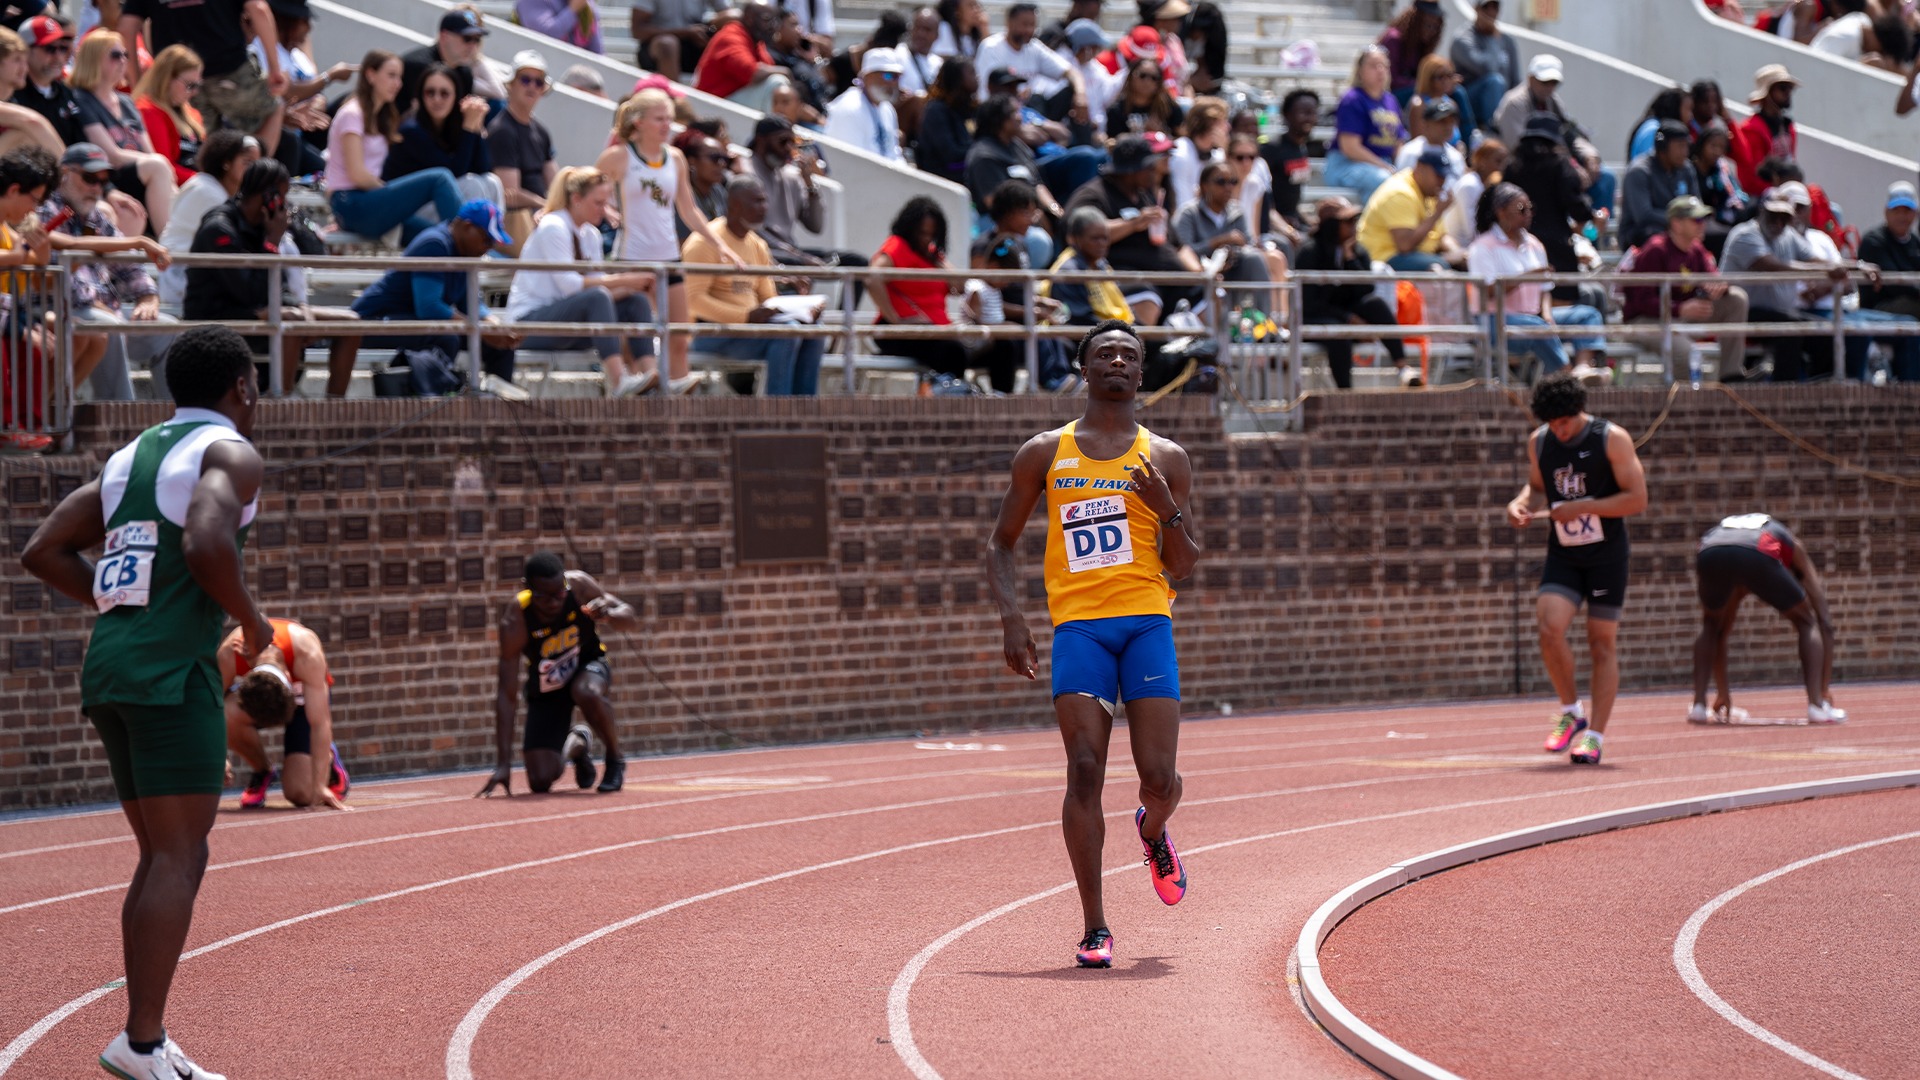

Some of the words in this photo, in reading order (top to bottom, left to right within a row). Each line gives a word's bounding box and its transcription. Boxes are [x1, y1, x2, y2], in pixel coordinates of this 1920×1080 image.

[1054, 478, 1089, 489] NEW
[1085, 500, 1110, 510] PENN
[1085, 505, 1118, 517] RELAYS
[1564, 514, 1595, 537] CX
[1072, 525, 1122, 557] DD
[101, 555, 138, 592] CB
